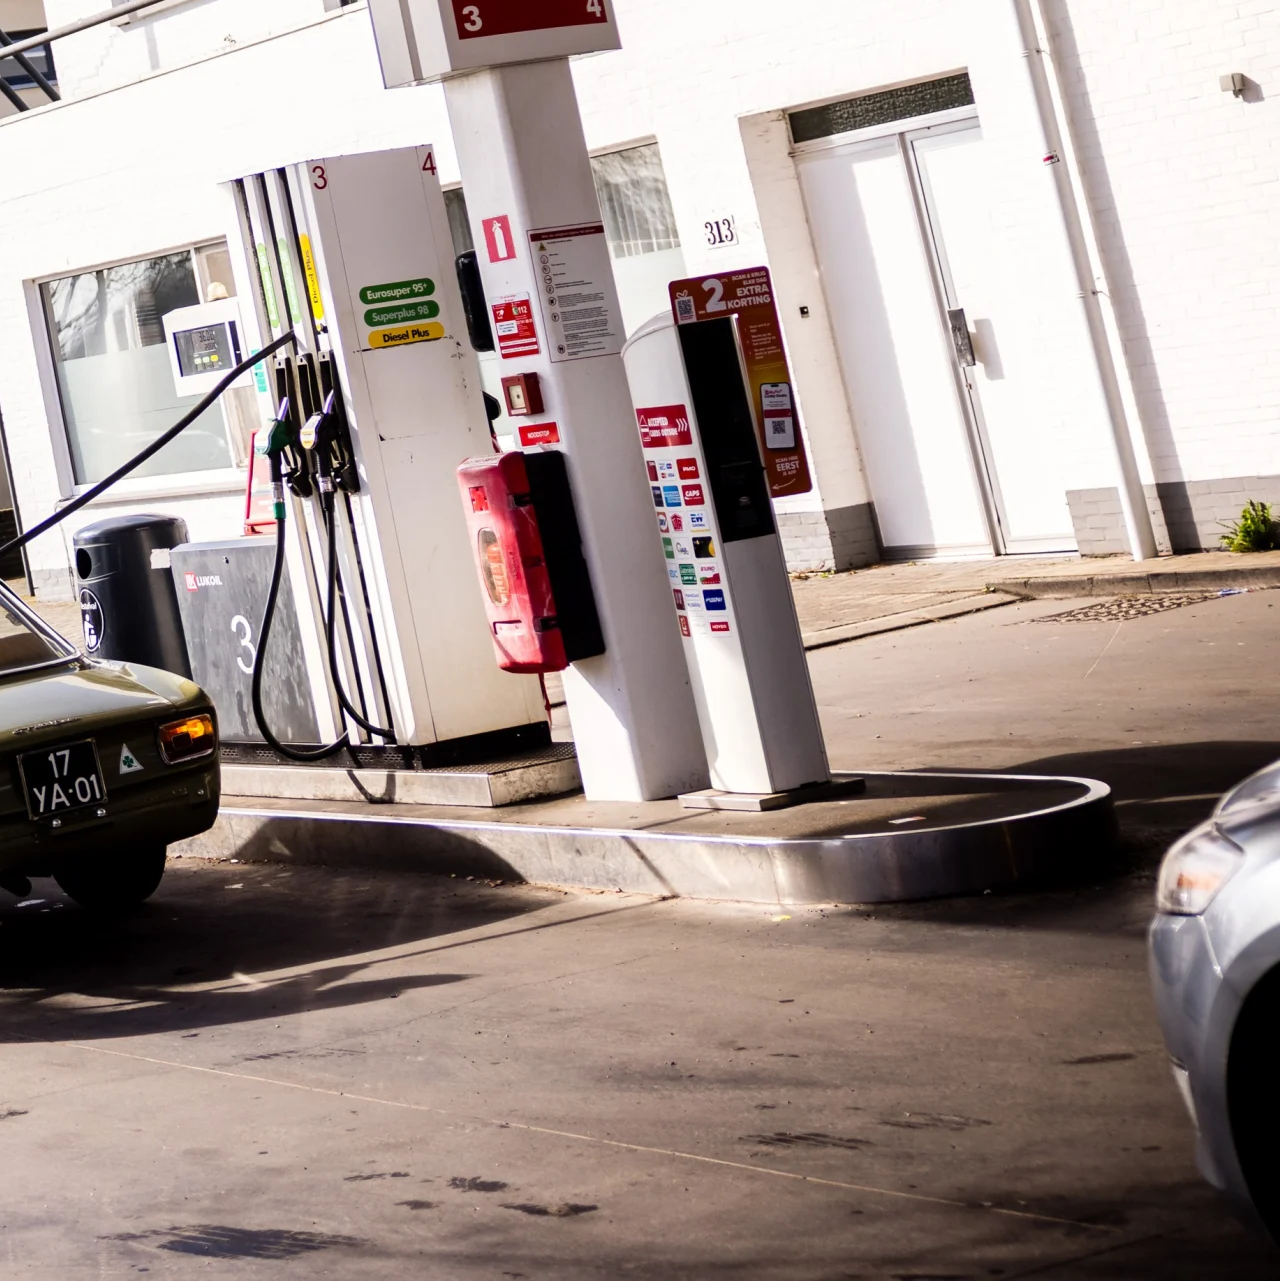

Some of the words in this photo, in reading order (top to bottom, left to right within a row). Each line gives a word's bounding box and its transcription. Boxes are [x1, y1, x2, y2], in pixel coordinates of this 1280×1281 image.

[462, 5, 483, 32] 3
[312, 165, 328, 190] 3
[422, 151, 437, 176] 4
[704, 218, 734, 246] 313
[366, 285, 411, 300] Eurosuper
[701, 278, 727, 313] 2
[736, 284, 769, 296] EXTRA
[727, 294, 771, 309] KORTING
[372, 308, 416, 323] Superplus
[417, 305, 429, 315] 98
[383, 331, 411, 344] Diesel
[412, 327, 430, 338] Plus
[776, 460, 800, 472] EERST
[685, 489, 700, 497] CAPS
[196, 575, 223, 587] LUKOIL
[230, 614, 257, 675] 3
[48, 749, 70, 778] 17
